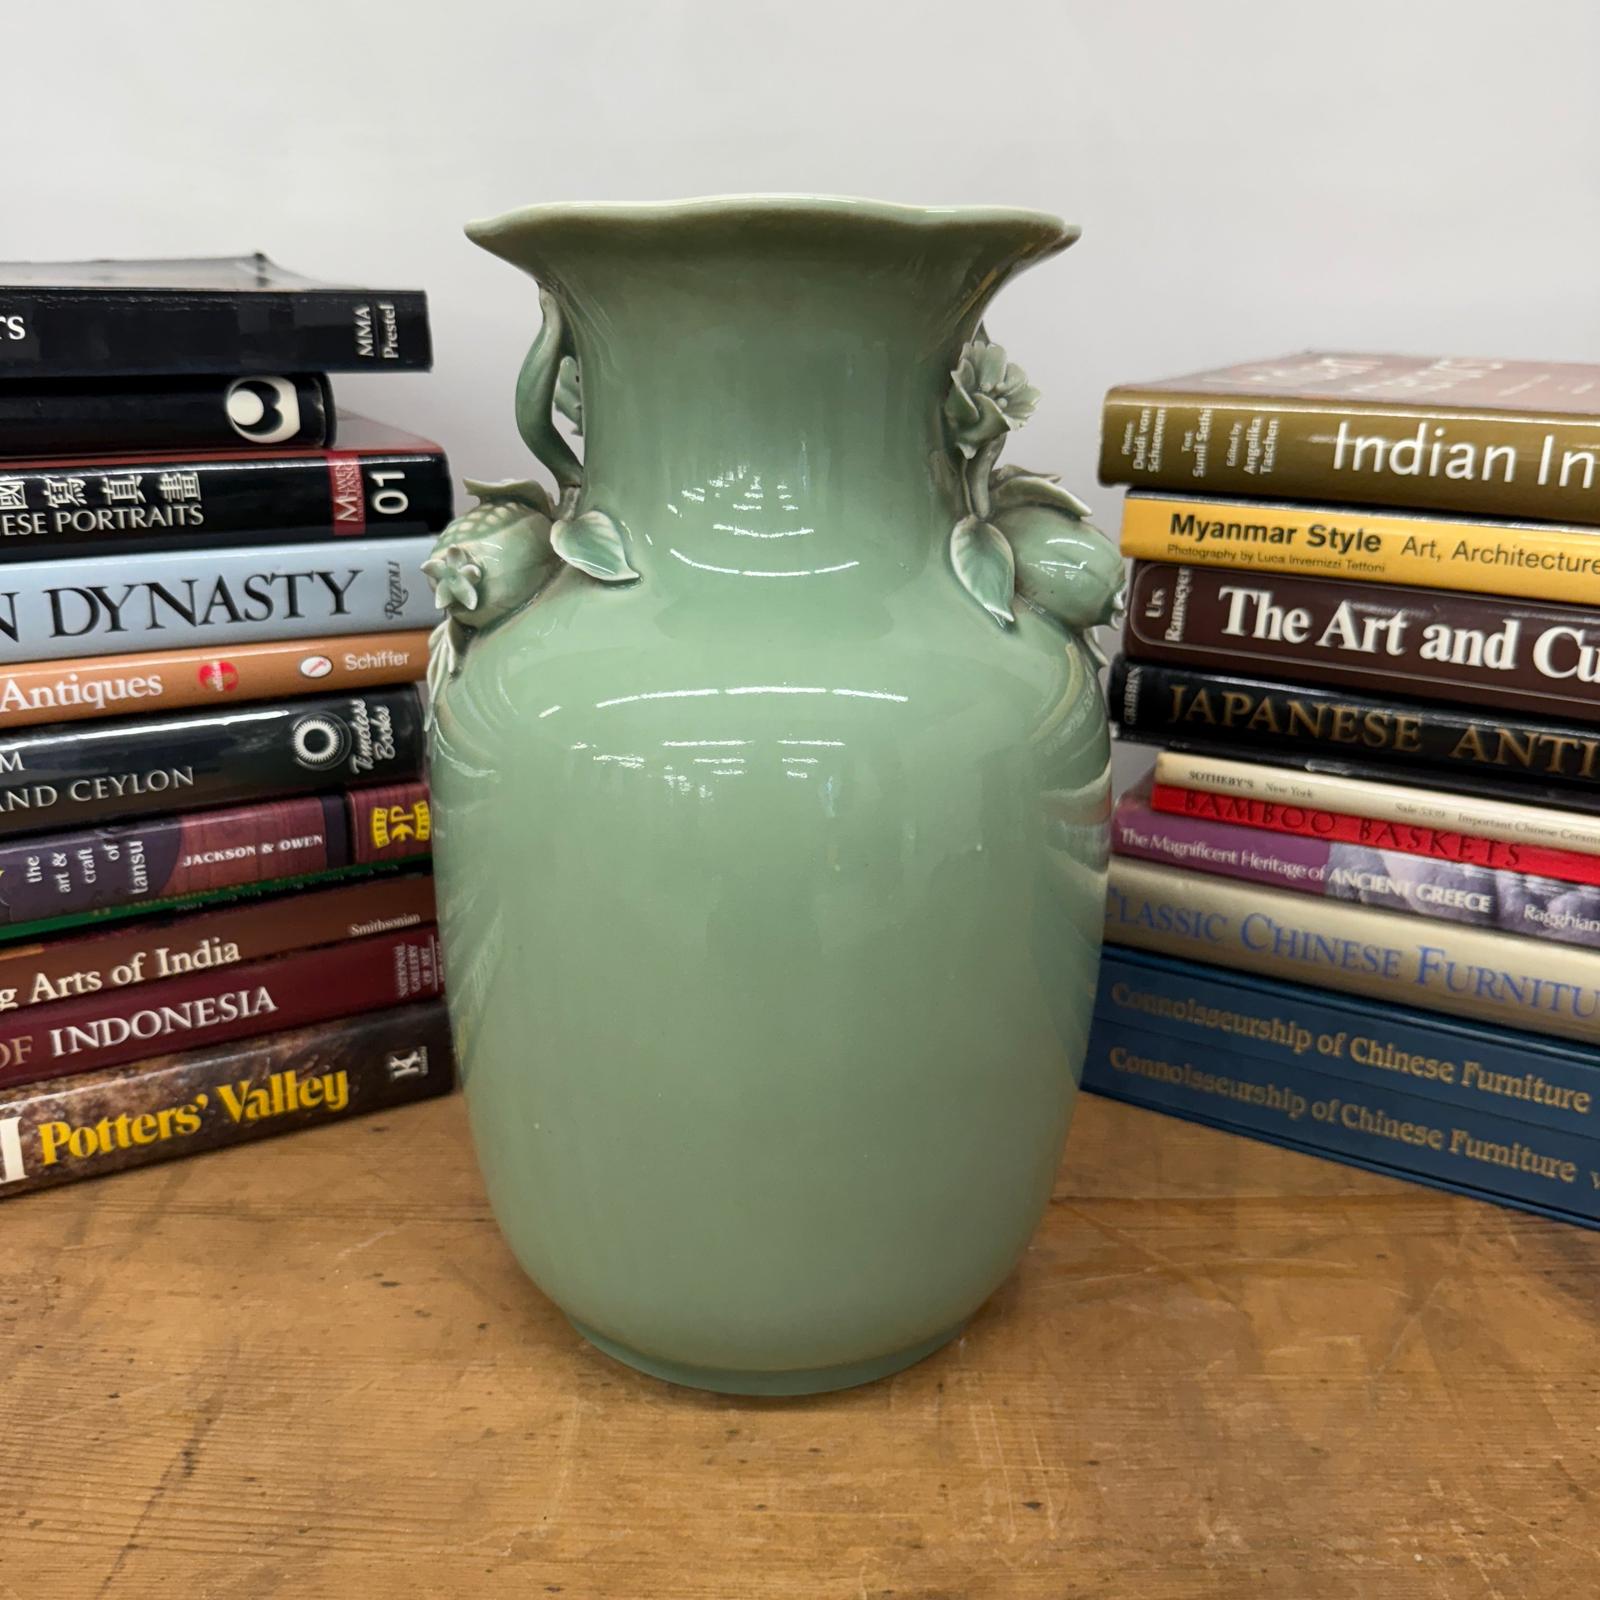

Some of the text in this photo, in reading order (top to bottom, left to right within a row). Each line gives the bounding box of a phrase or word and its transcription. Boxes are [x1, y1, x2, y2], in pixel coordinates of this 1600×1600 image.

[353, 304, 374, 357] MMA
[376, 302, 399, 359] Prestel
[1138, 408, 1150, 433] von
[1147, 408, 1167, 473] Schaewen
[1243, 417, 1261, 475] Angelika
[1260, 419, 1279, 475] Taschen
[1192, 444, 1207, 478] Sunil
[1332, 420, 1596, 489] Indian In
[55, 504, 205, 534] PORTRAITS
[370, 470, 409, 515] 01
[1167, 543, 1386, 573] Photography by Luca Invernizzi Tettoni
[1169, 513, 1600, 576] Myanmar Style Art, Architecture
[43, 569, 362, 638] DYNASTY
[1145, 588, 1167, 618] Urs
[1164, 567, 1193, 642] Ramseyer
[1217, 584, 1311, 640] The
[1317, 600, 1408, 656] Art
[1419, 619, 1517, 671] and
[344, 650, 410, 671] Schiffer
[1, 673, 164, 711] Antiques
[350, 697, 373, 775] Timeless
[370, 703, 396, 760] Books
[1168, 684, 1600, 778] JAPANESE ANTI
[70, 766, 194, 802] CEYLON
[1189, 770, 1254, 788] SOTHEBY'S
[1265, 782, 1287, 793] New
[1290, 785, 1315, 799] York
[1457, 813, 1512, 831] Important
[1514, 820, 1558, 837] Chinese
[102, 843, 120, 861] of
[181, 834, 324, 869] JACKSON & OWEN
[1183, 790, 1520, 867] BAMBOO BASKETS
[27, 855, 42, 884] the
[52, 852, 72, 893] art &
[77, 847, 96, 884] craft
[128, 841, 149, 895] tansu
[1120, 826, 1600, 932] The Magnificent Heritage of ANCIENT GREECE Ragghian
[350, 912, 421, 937] Smithsonian
[32, 972, 103, 1005] Arts
[112, 957, 147, 985] of
[156, 936, 242, 976] India
[1239, 912, 1402, 979] CHINESE
[1415, 945, 1600, 1020] FURNITU
[50, 985, 279, 1058] INDONESIA
[1111, 981, 1592, 1115] Connoisseurship of Chinese Furniture
[216, 1069, 350, 1125] Valley
[1110, 1046, 1577, 1184] Connoisseurship of Chinese Furniture
